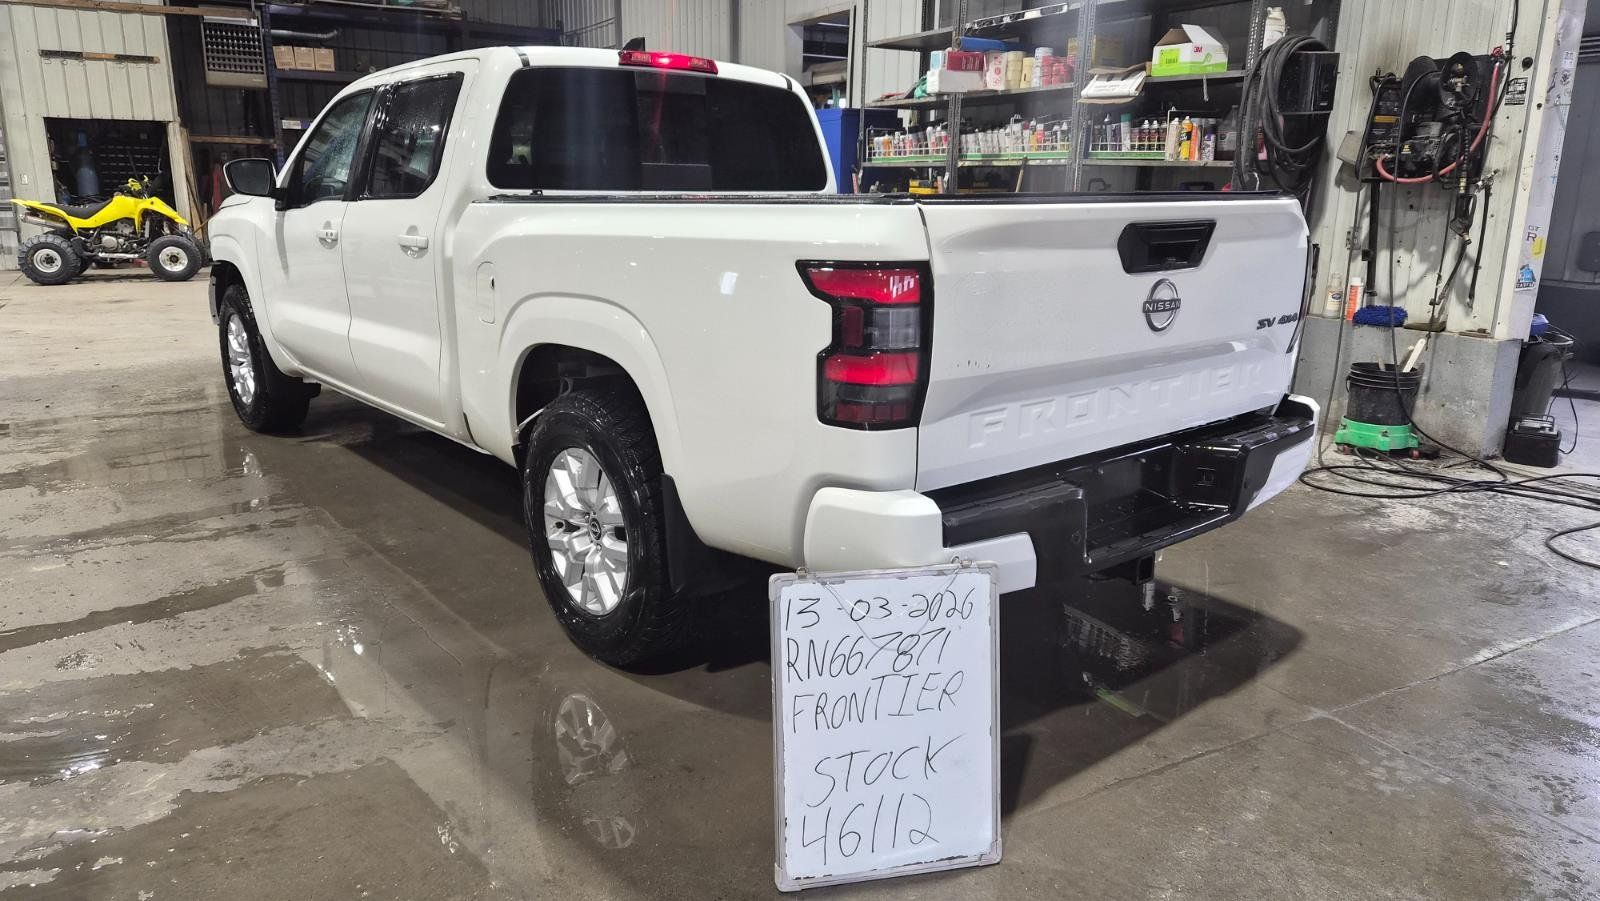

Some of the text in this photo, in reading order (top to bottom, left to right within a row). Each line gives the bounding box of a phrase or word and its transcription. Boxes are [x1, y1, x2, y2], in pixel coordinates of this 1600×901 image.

[1144, 299, 1181, 311] NISSAN
[1256, 317, 1276, 330] SV
[967, 362, 1264, 449] FRONTIER
[787, 627, 951, 683] RN667871
[792, 670, 964, 733] FRONTIER
[806, 732, 967, 807] STOCK
[801, 793, 940, 866] 46112
